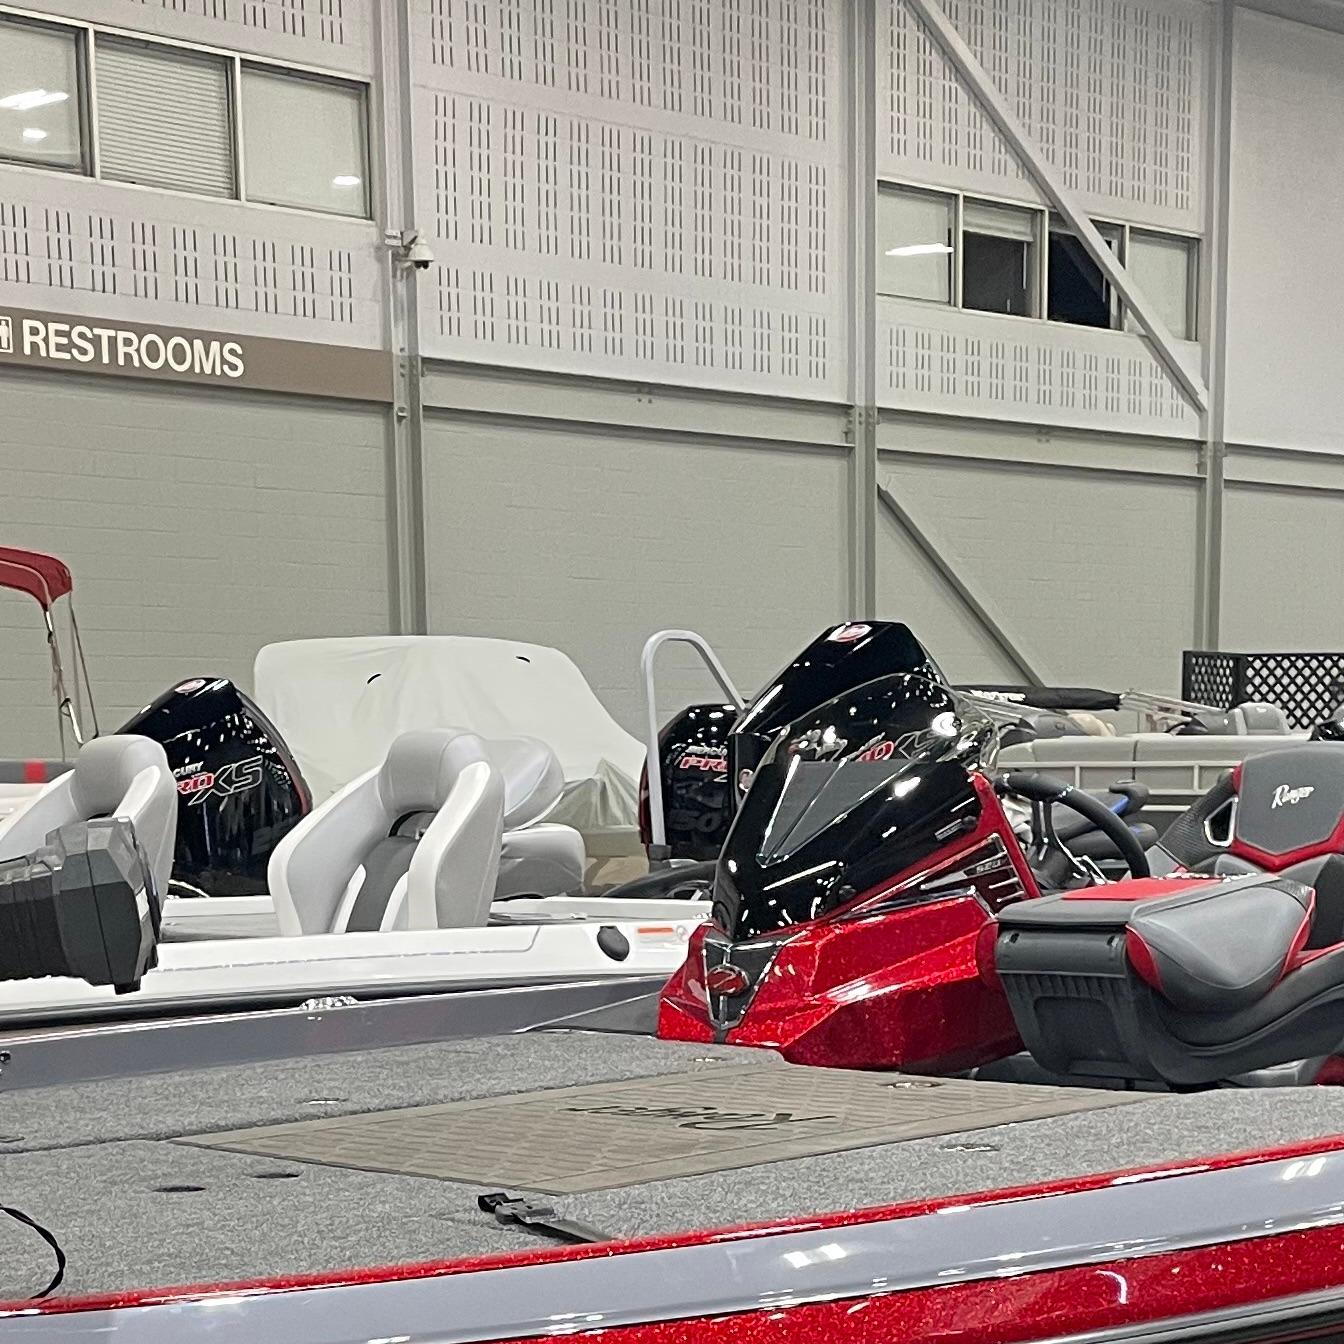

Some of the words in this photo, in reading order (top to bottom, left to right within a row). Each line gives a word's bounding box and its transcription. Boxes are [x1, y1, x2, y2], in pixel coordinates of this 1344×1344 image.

[22, 319, 245, 379] RESTROOMS
[173, 761, 204, 777] CURY
[1271, 784, 1315, 809] Ranger
